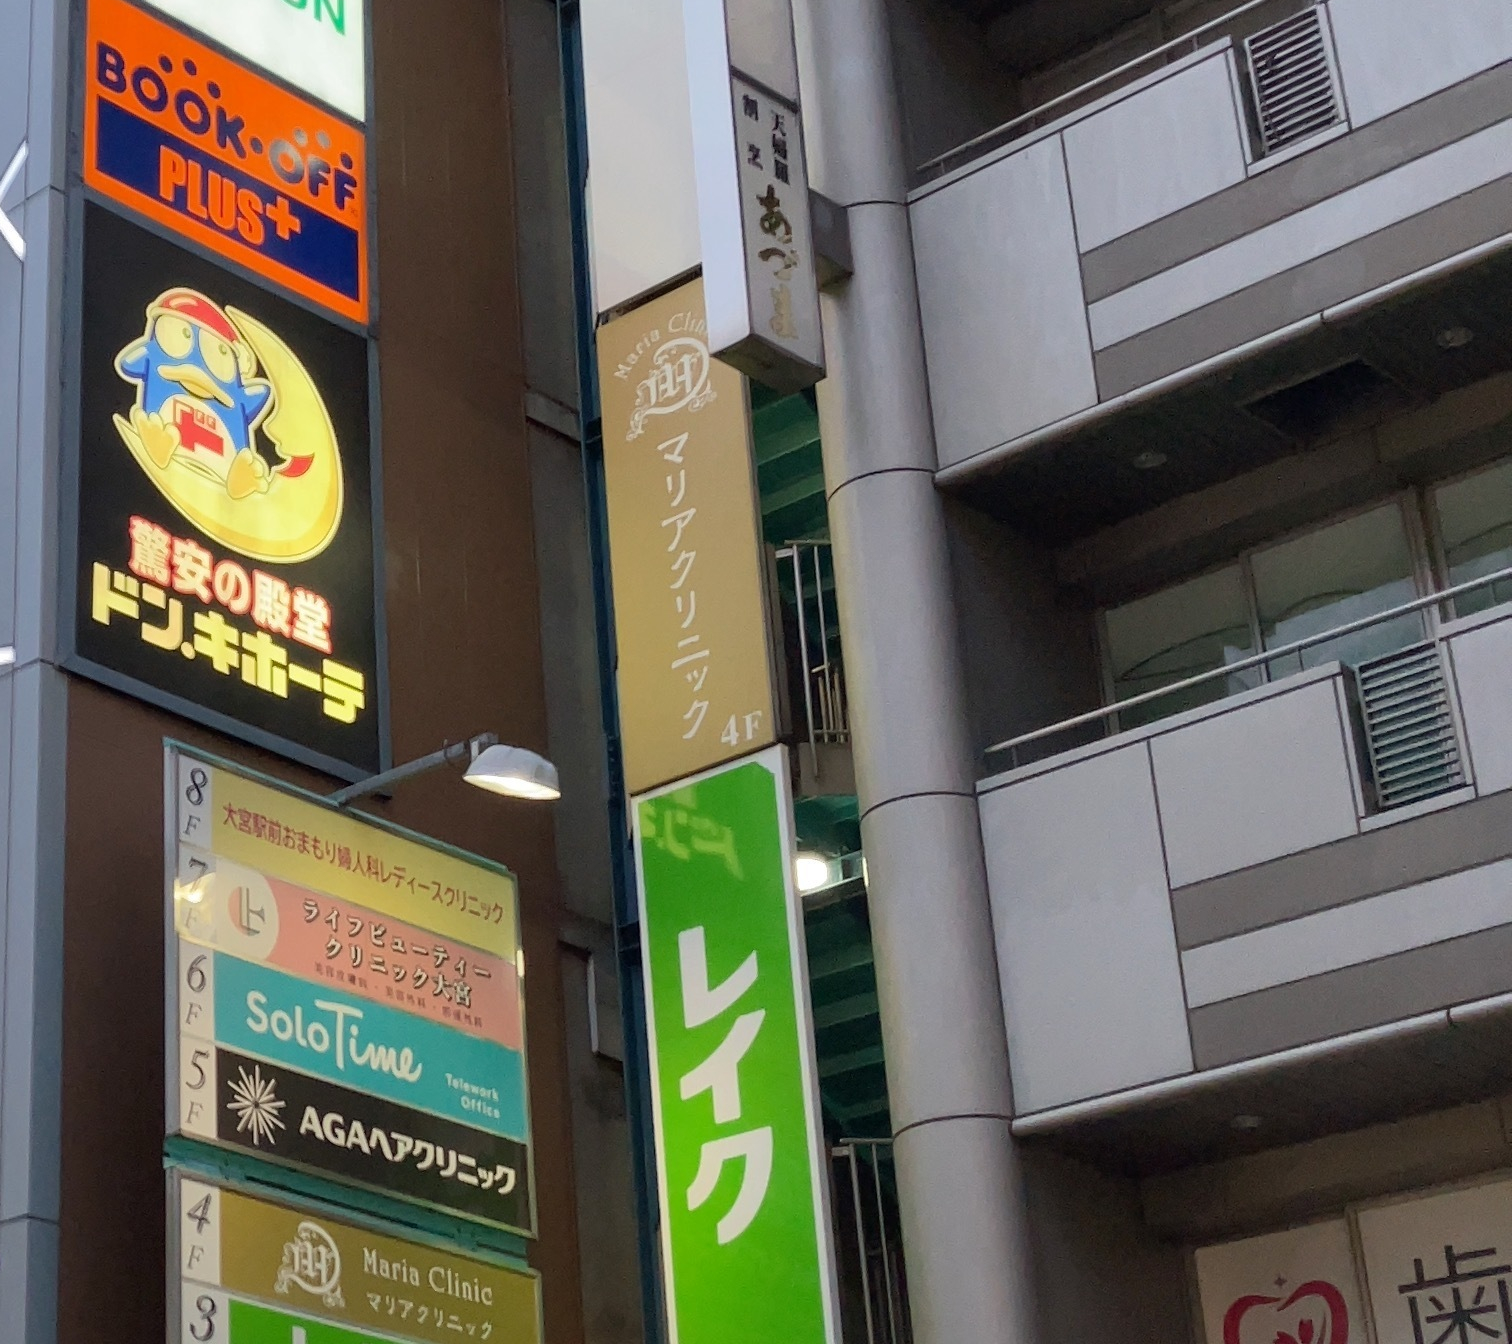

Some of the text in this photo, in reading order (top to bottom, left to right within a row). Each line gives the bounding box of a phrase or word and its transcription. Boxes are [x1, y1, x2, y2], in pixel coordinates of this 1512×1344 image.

[656, 431, 711, 741] マリアクリニック
[720, 710, 763, 747] 4F
[302, 897, 494, 983] ライフビューティー
[324, 938, 473, 1009] クリニック大宮
[445, 1072, 500, 1103] Telework
[460, 1094, 502, 1119] Office
[677, 924, 774, 1246] レイク
[361, 1246, 494, 1307] Maria Clinic
[365, 1290, 494, 1341] マリアクリニック
